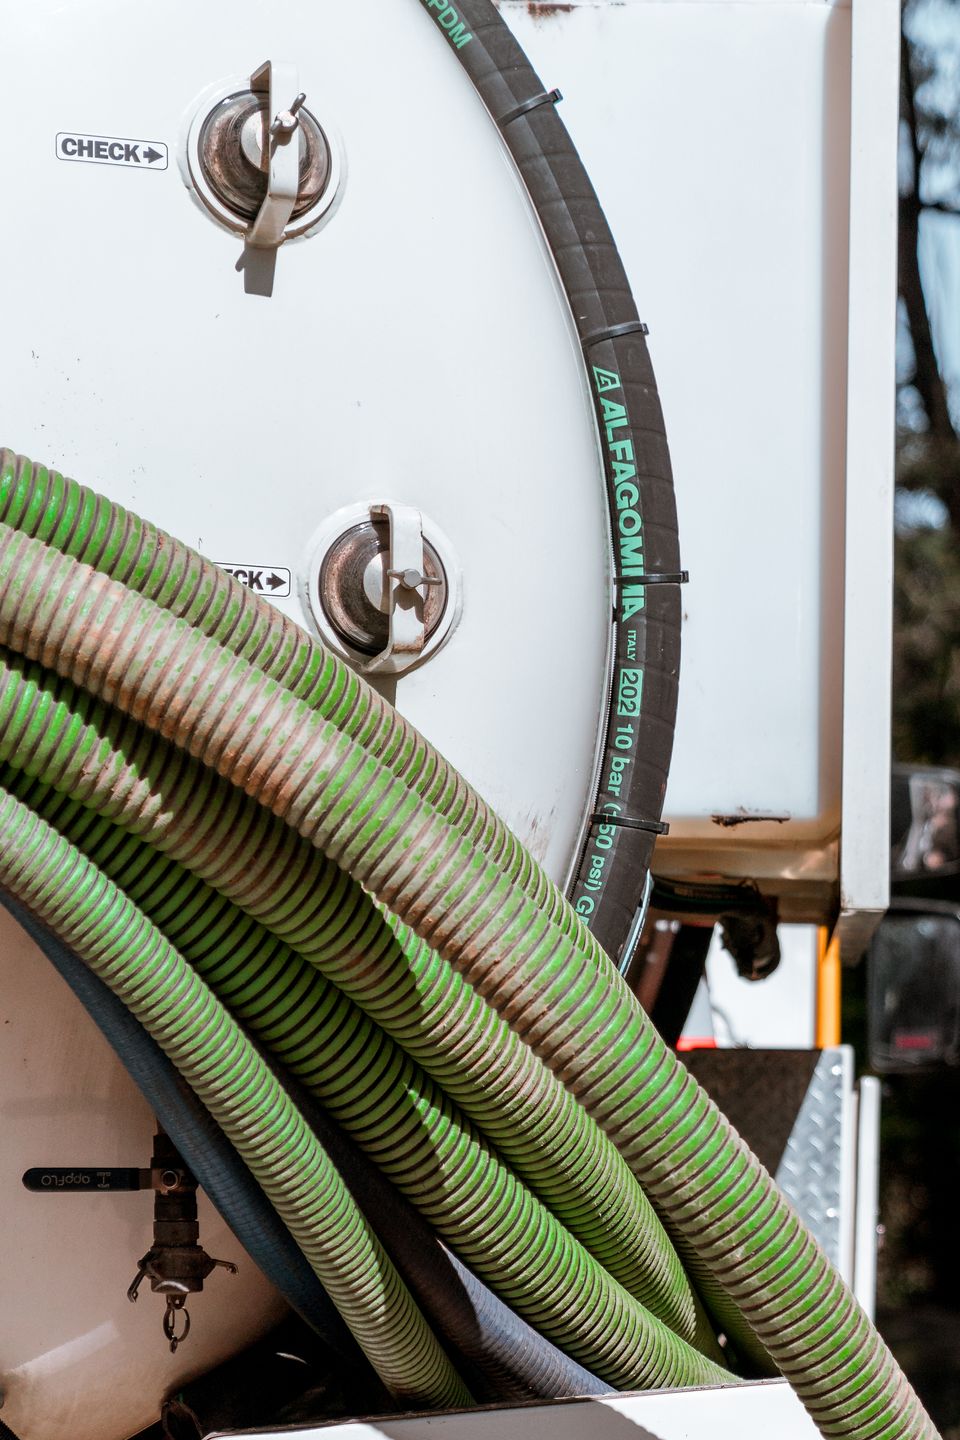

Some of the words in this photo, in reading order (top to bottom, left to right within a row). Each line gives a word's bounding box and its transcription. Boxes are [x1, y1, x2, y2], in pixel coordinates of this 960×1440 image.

[425, 0, 474, 49] PDM
[61, 137, 141, 163] CHECK
[600, 397, 645, 622] ALFAGOMMA
[627, 629, 637, 661] ITALY
[619, 671, 640, 714] 202
[614, 723, 634, 750] 10
[608, 756, 632, 797] bar
[584, 854, 605, 892] psi)
